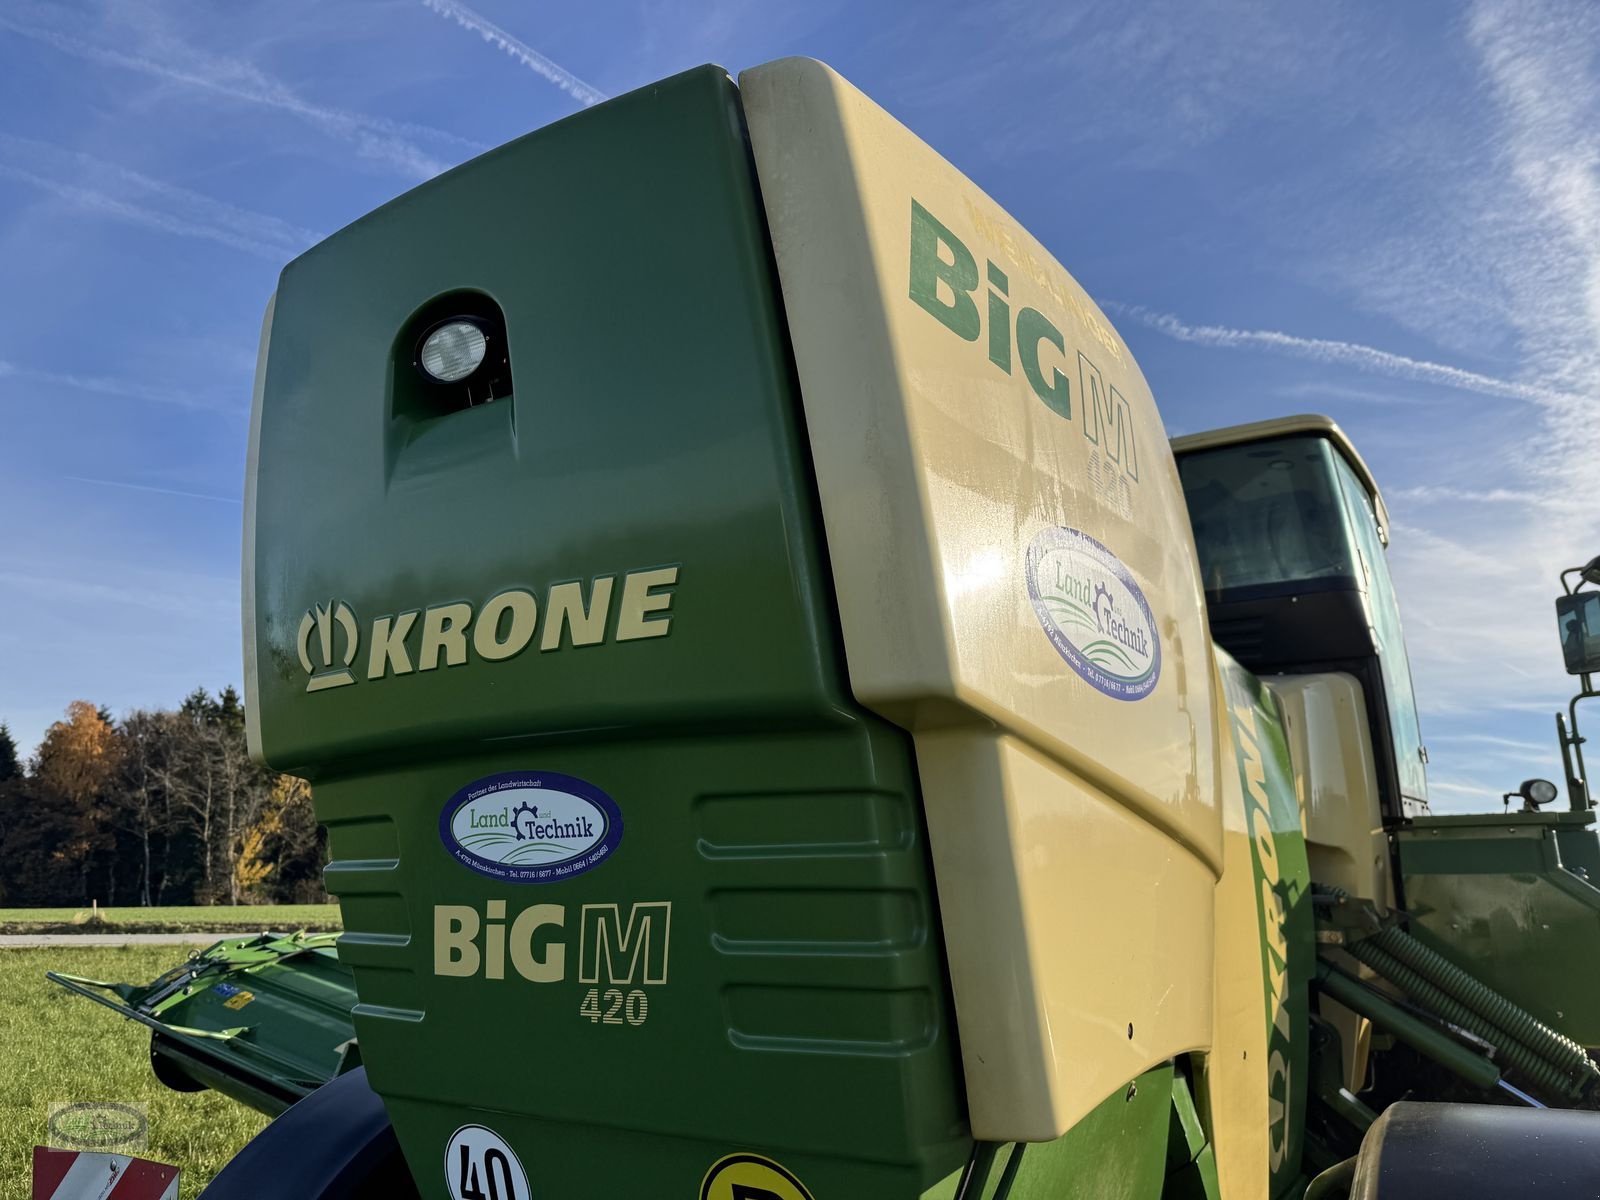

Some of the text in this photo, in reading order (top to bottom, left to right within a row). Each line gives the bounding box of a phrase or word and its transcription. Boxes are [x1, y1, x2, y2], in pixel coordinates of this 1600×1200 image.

[908, 196, 1139, 484] BiG M
[1055, 560, 1091, 607] Land
[367, 563, 680, 681] KRONE
[1103, 606, 1149, 659] Technik
[467, 788, 488, 801] Partner
[487, 784, 498, 792] der
[470, 807, 509, 828] Land
[525, 816, 594, 840] Technik
[509, 870, 520, 878] Tel.
[520, 871, 535, 879] 07716
[555, 864, 573, 876] Mobil
[434, 899, 672, 985] BiG M
[580, 988, 648, 1026] 420
[460, 1144, 516, 1200] 40
